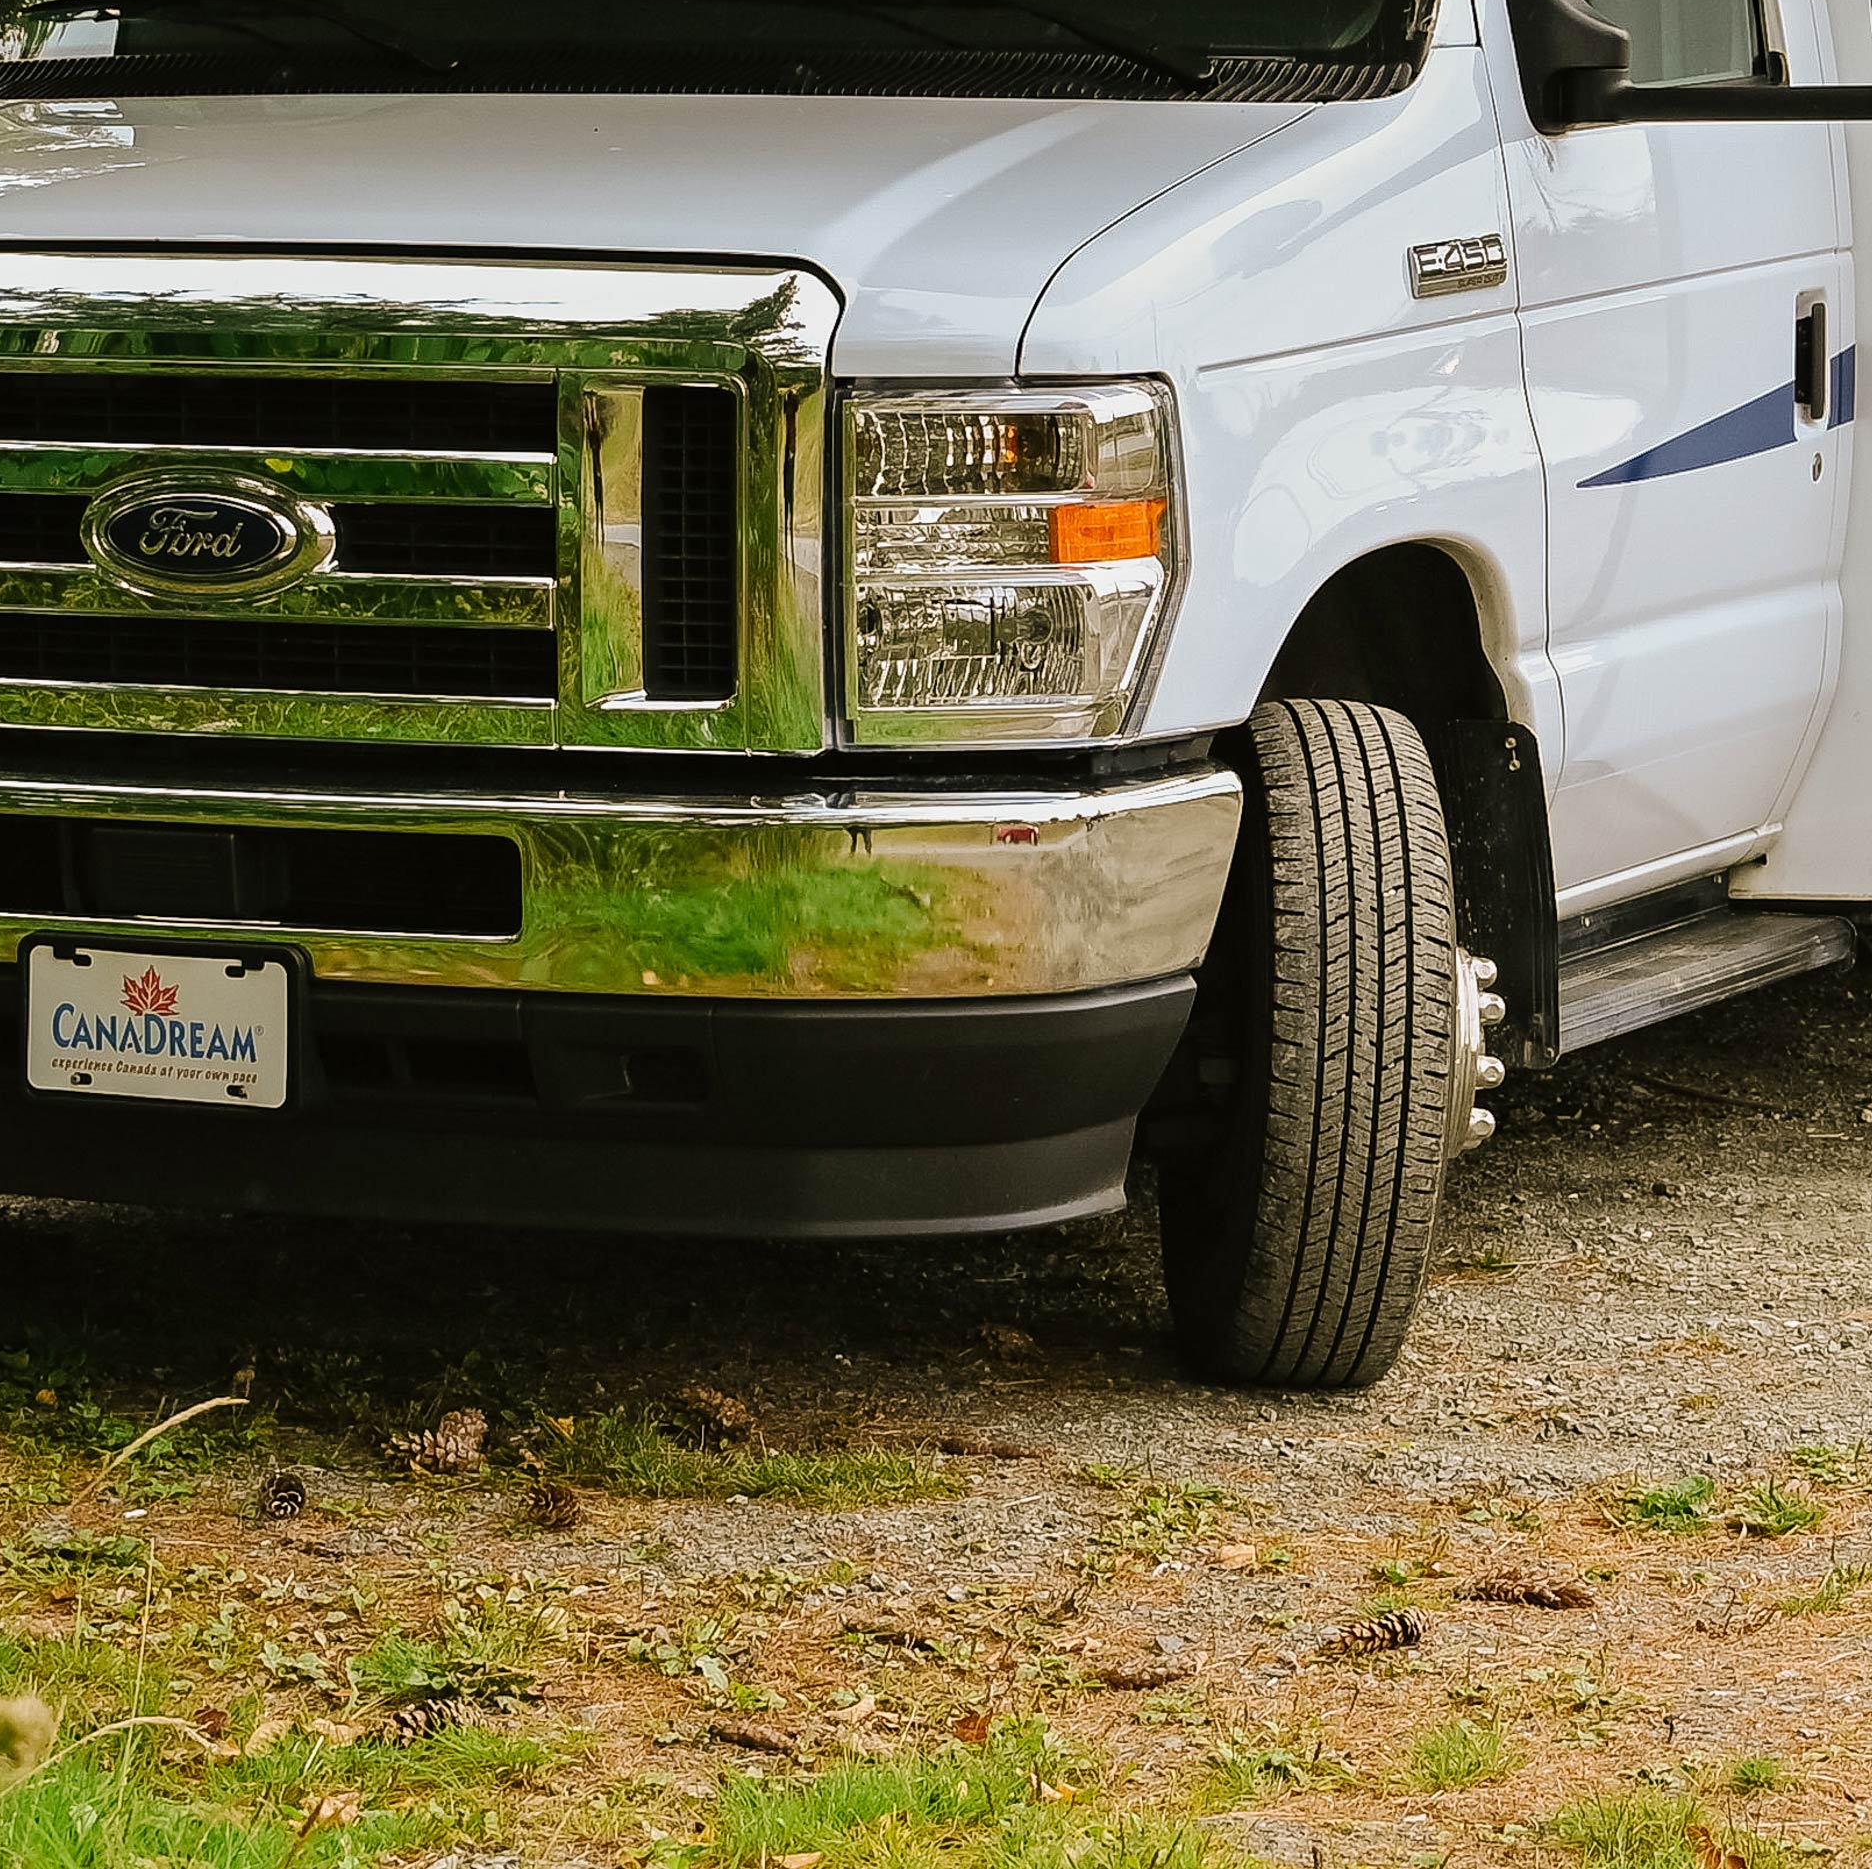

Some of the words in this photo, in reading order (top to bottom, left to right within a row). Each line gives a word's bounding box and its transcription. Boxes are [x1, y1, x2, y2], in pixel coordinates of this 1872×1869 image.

[138, 506, 245, 557] Ford
[51, 1058, 113, 1072] experience
[115, 1060, 156, 1076] Canada
